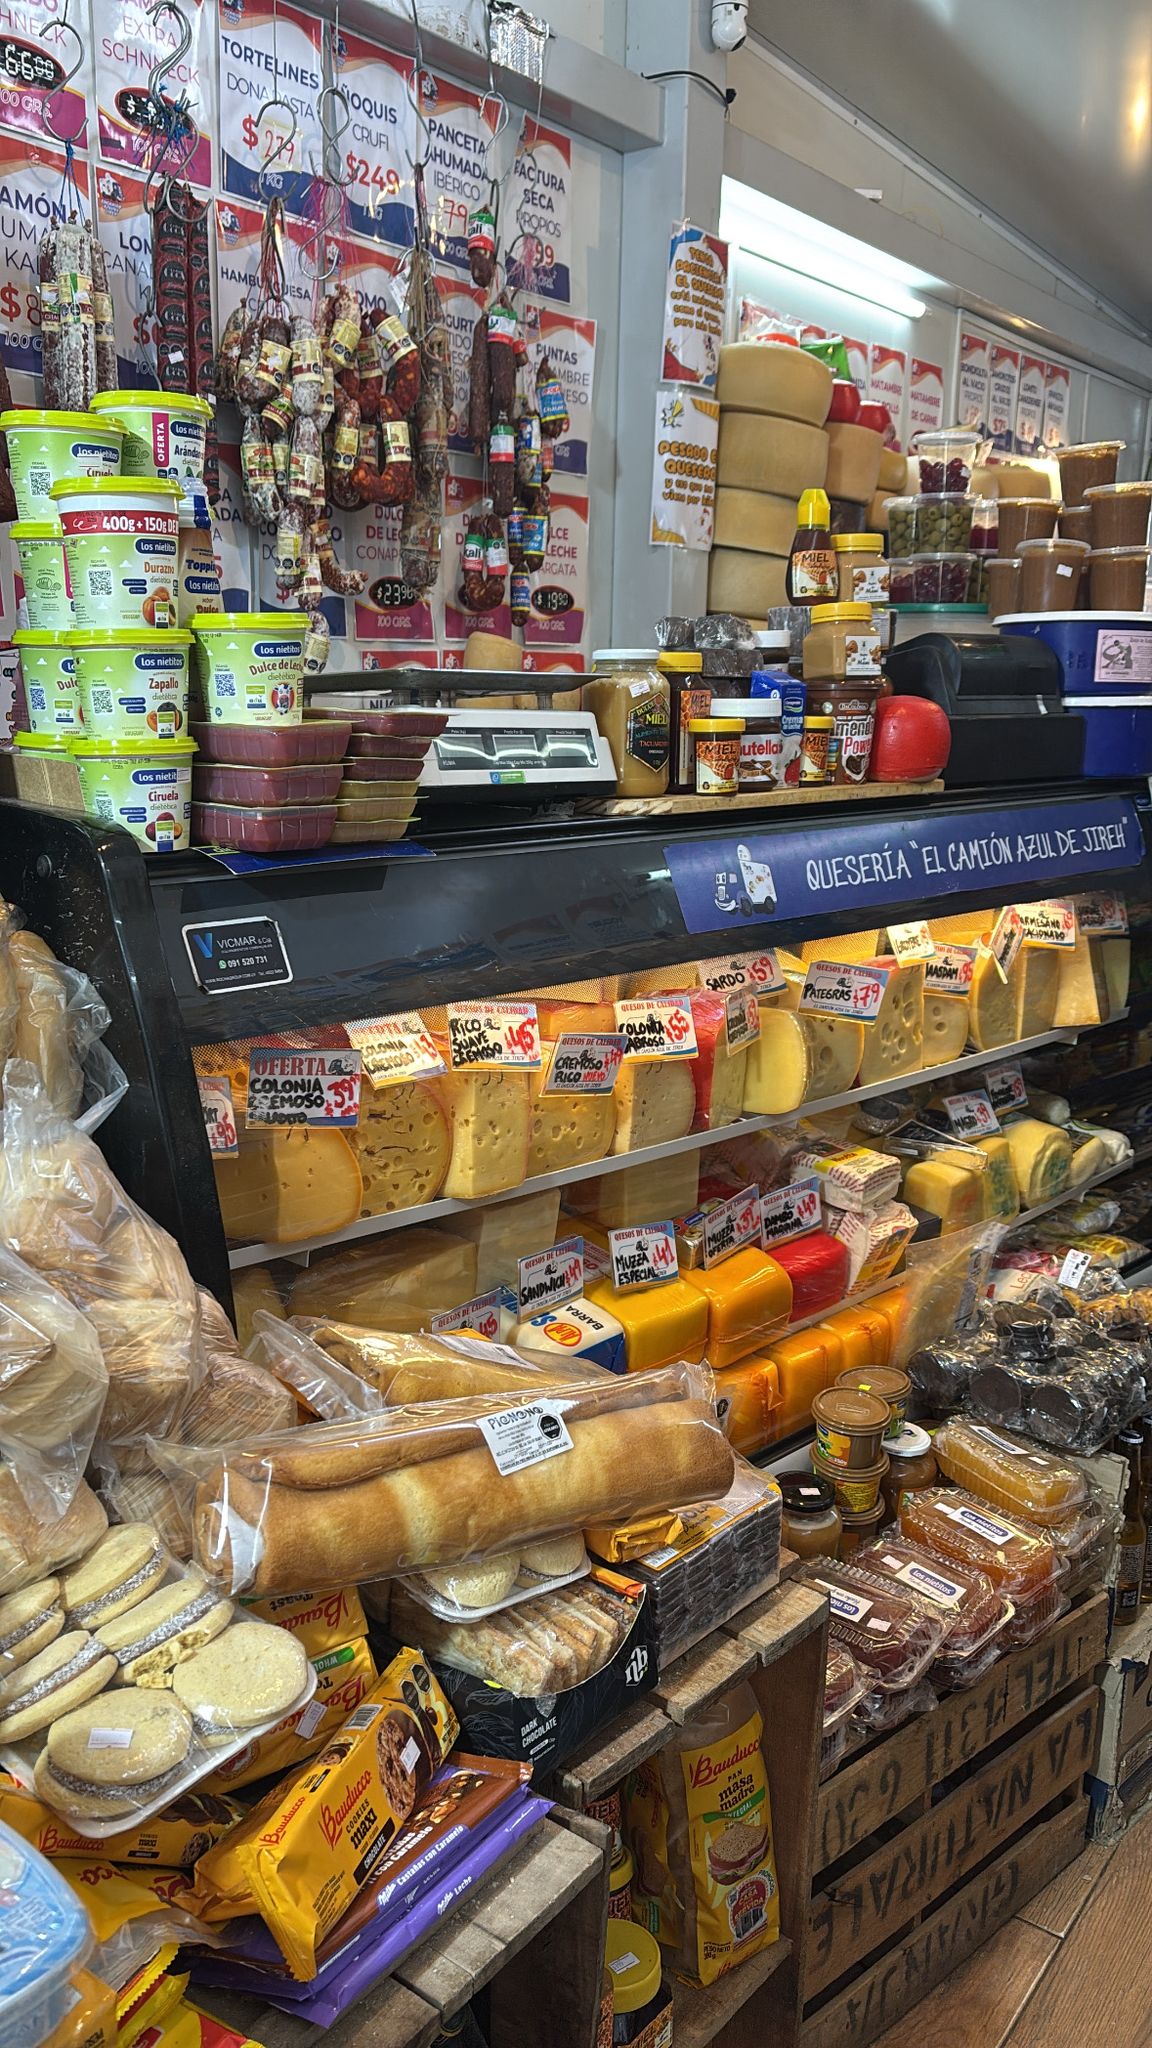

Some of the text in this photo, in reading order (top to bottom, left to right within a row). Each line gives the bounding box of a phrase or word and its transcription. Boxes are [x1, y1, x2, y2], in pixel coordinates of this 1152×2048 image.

[123, 15, 177, 49] EXTRA
[221, 35, 319, 90] TORTELINES
[352, 123, 390, 151] CRUFI
[428, 118, 487, 155] PANCETA
[346, 150, 401, 195] $249
[514, 158, 566, 195] FACTURA
[433, 169, 481, 201] IBÉRICO
[523, 188, 555, 214] SECA
[536, 342, 578, 366] PUNTAS
[156, 422, 166, 462] OFERTA
[658, 440, 709, 463] PESADO
[102, 515, 167, 533] 400g 150g
[802, 552, 829, 563] MIEL
[144, 562, 175, 575] Durazno
[275, 644, 302, 655] nietitos
[156, 656, 184, 668] nietitos
[249, 660, 278, 675] Dulce
[148, 676, 180, 691] Zapallo
[645, 713, 667, 726] MIEL
[703, 743, 738, 756] MIEL
[148, 790, 180, 802] Ciruela
[805, 842, 913, 892] QUESERÍA
[948, 831, 1014, 872] CAMIÓN
[1016, 832, 1055, 865] AZUL
[1055, 829, 1082, 857] DE
[216, 935, 257, 950] VICMAR
[227, 955, 269, 969] 091 520 731
[815, 963, 841, 974] QUESOS
[842, 966, 852, 975] DE
[705, 971, 745, 991] SARDO
[803, 982, 853, 1001] PATEGRAS
[852, 982, 881, 1008] $79
[621, 1000, 685, 1013] QUESOS DE CALIDAD
[450, 1017, 482, 1038] RICO
[619, 1020, 665, 1037] COLONIA
[451, 1030, 490, 1050] SUAVE
[561, 1037, 585, 1046] QUESOS
[586, 1037, 594, 1045] DE
[451, 1042, 503, 1068] CREMOSO
[554, 1056, 603, 1072] CREMOSO
[254, 1057, 327, 1076] OFERTA
[250, 1077, 325, 1095] COLONIA
[554, 1070, 582, 1084] RICO
[763, 1196, 782, 1207] QUESOS
[781, 1192, 790, 1201] DE
[707, 1206, 734, 1225] QUESOS DE
[763, 1209, 794, 1229] DAMBO
[614, 1231, 636, 1242] QUESOS
[635, 1230, 645, 1238] DE
[707, 1224, 736, 1246] MUZZA
[708, 1236, 736, 1259] OFERTA
[524, 1255, 546, 1270] QUESOS
[546, 1252, 555, 1260] DE
[615, 1250, 650, 1273] MUZZA
[618, 1266, 660, 1286] ESPECIAL
[519, 1275, 566, 1308] SANDWICH
[438, 1314, 462, 1328] QUESOS
[461, 1309, 471, 1317] DE
[564, 1304, 605, 1331] BARRA
[923, 1576, 955, 1596] nietitos
[520, 1717, 539, 1737] DARK
[522, 1715, 558, 1748] CHOCOLATE
[727, 1768, 743, 1783] PAN
[718, 1773, 755, 1803] masa
[719, 1783, 756, 1812] madre
[318, 1769, 372, 1852] Bauducco
[345, 1798, 371, 1834] COOKIES
[259, 1796, 306, 1848] Bauducco
[349, 1807, 379, 1850] maxi
[39, 1824, 105, 1855] Bauducco
[363, 1833, 387, 1870] CHOCOLATE
[374, 1825, 434, 1877] con Caramelo
[396, 1859, 427, 1886] Castañas
[424, 1850, 438, 1863] con
[435, 1825, 464, 1852] Caramelo
[453, 1875, 472, 1896] Leche
